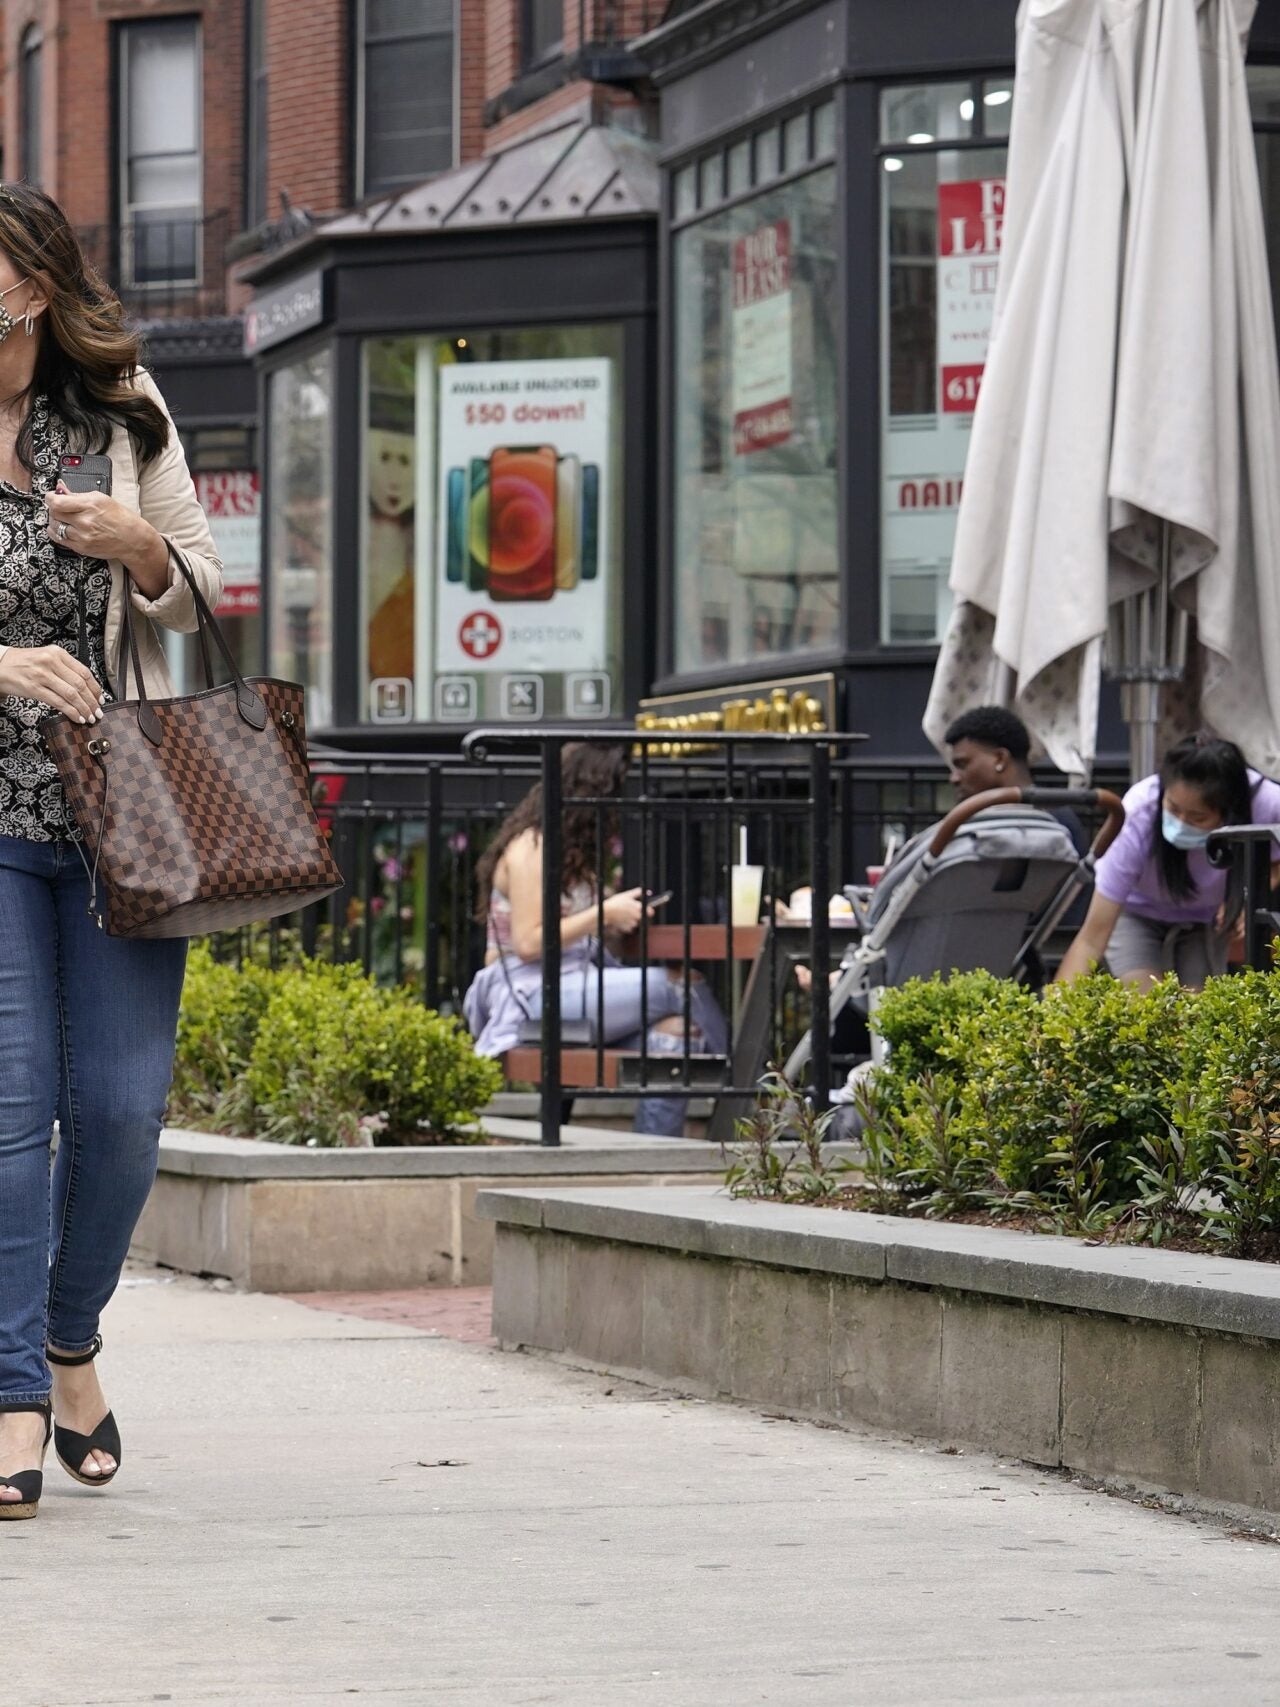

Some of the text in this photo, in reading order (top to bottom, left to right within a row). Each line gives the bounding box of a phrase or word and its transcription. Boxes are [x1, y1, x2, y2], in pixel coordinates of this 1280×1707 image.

[950, 217, 1003, 256] LE
[735, 255, 787, 307] LEASE
[451, 377, 600, 395] AVAILABLE UNLOCKED
[946, 376, 982, 401] 61
[465, 401, 586, 426] $50 down!
[199, 472, 255, 493] FOR
[509, 626, 584, 642] BOSTON
